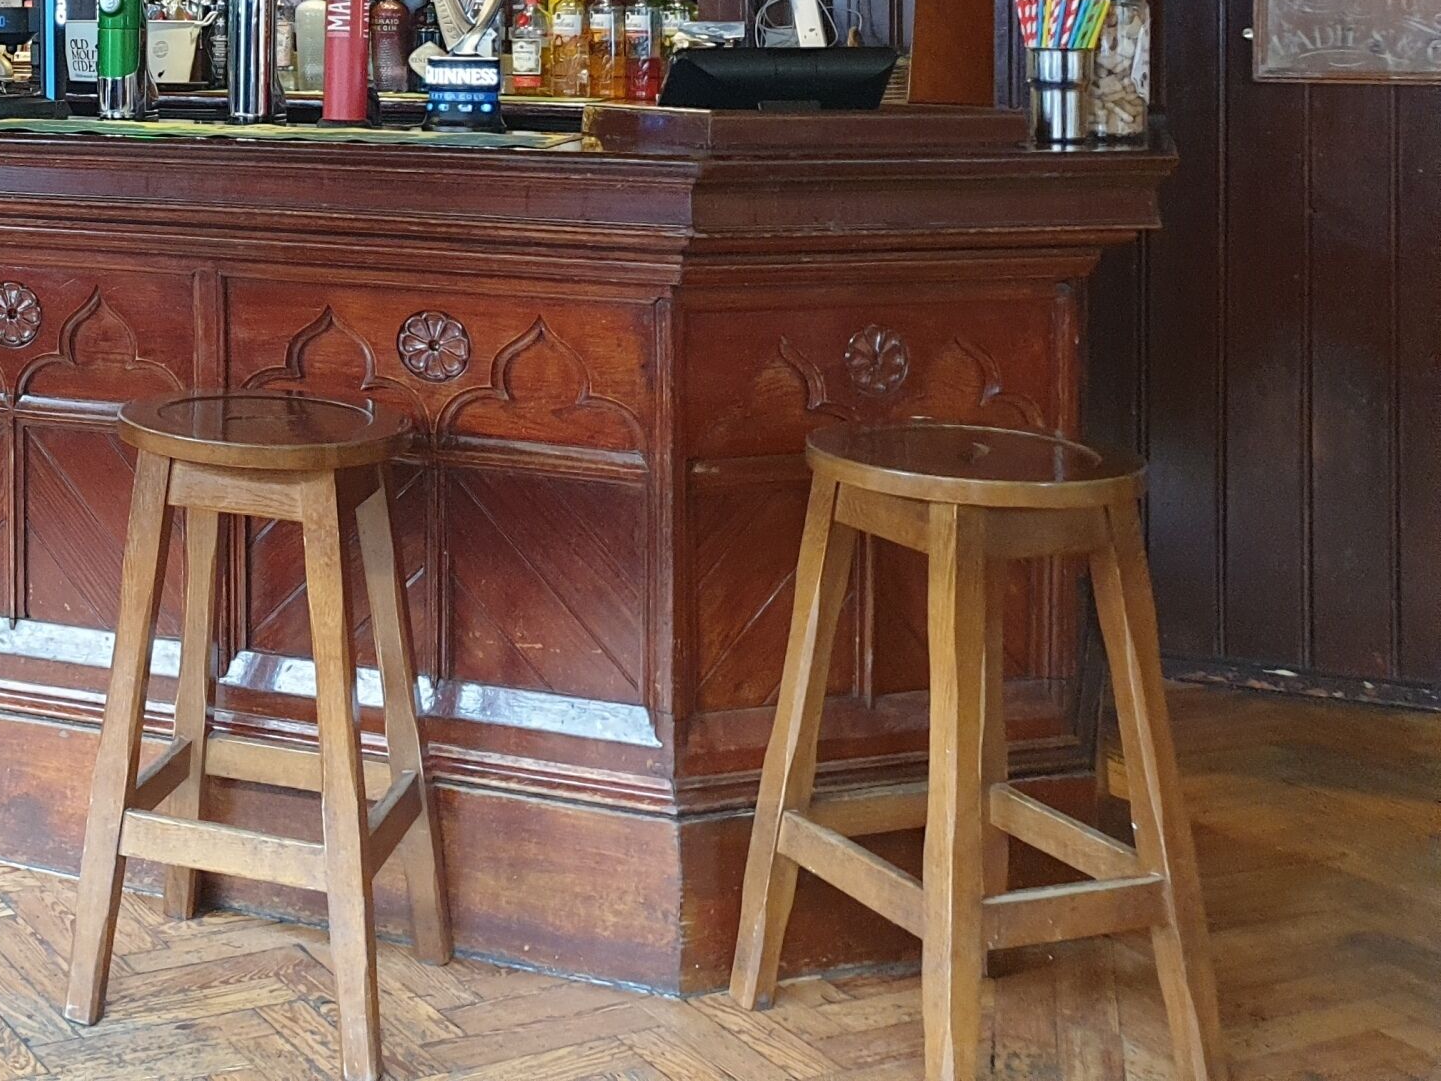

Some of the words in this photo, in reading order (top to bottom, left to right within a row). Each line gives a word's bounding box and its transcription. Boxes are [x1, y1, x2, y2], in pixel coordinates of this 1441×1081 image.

[70, 38, 89, 50] OLD
[71, 49, 98, 61] MOU
[72, 60, 98, 72] CIDE
[426, 67, 499, 86] GUINNESS
